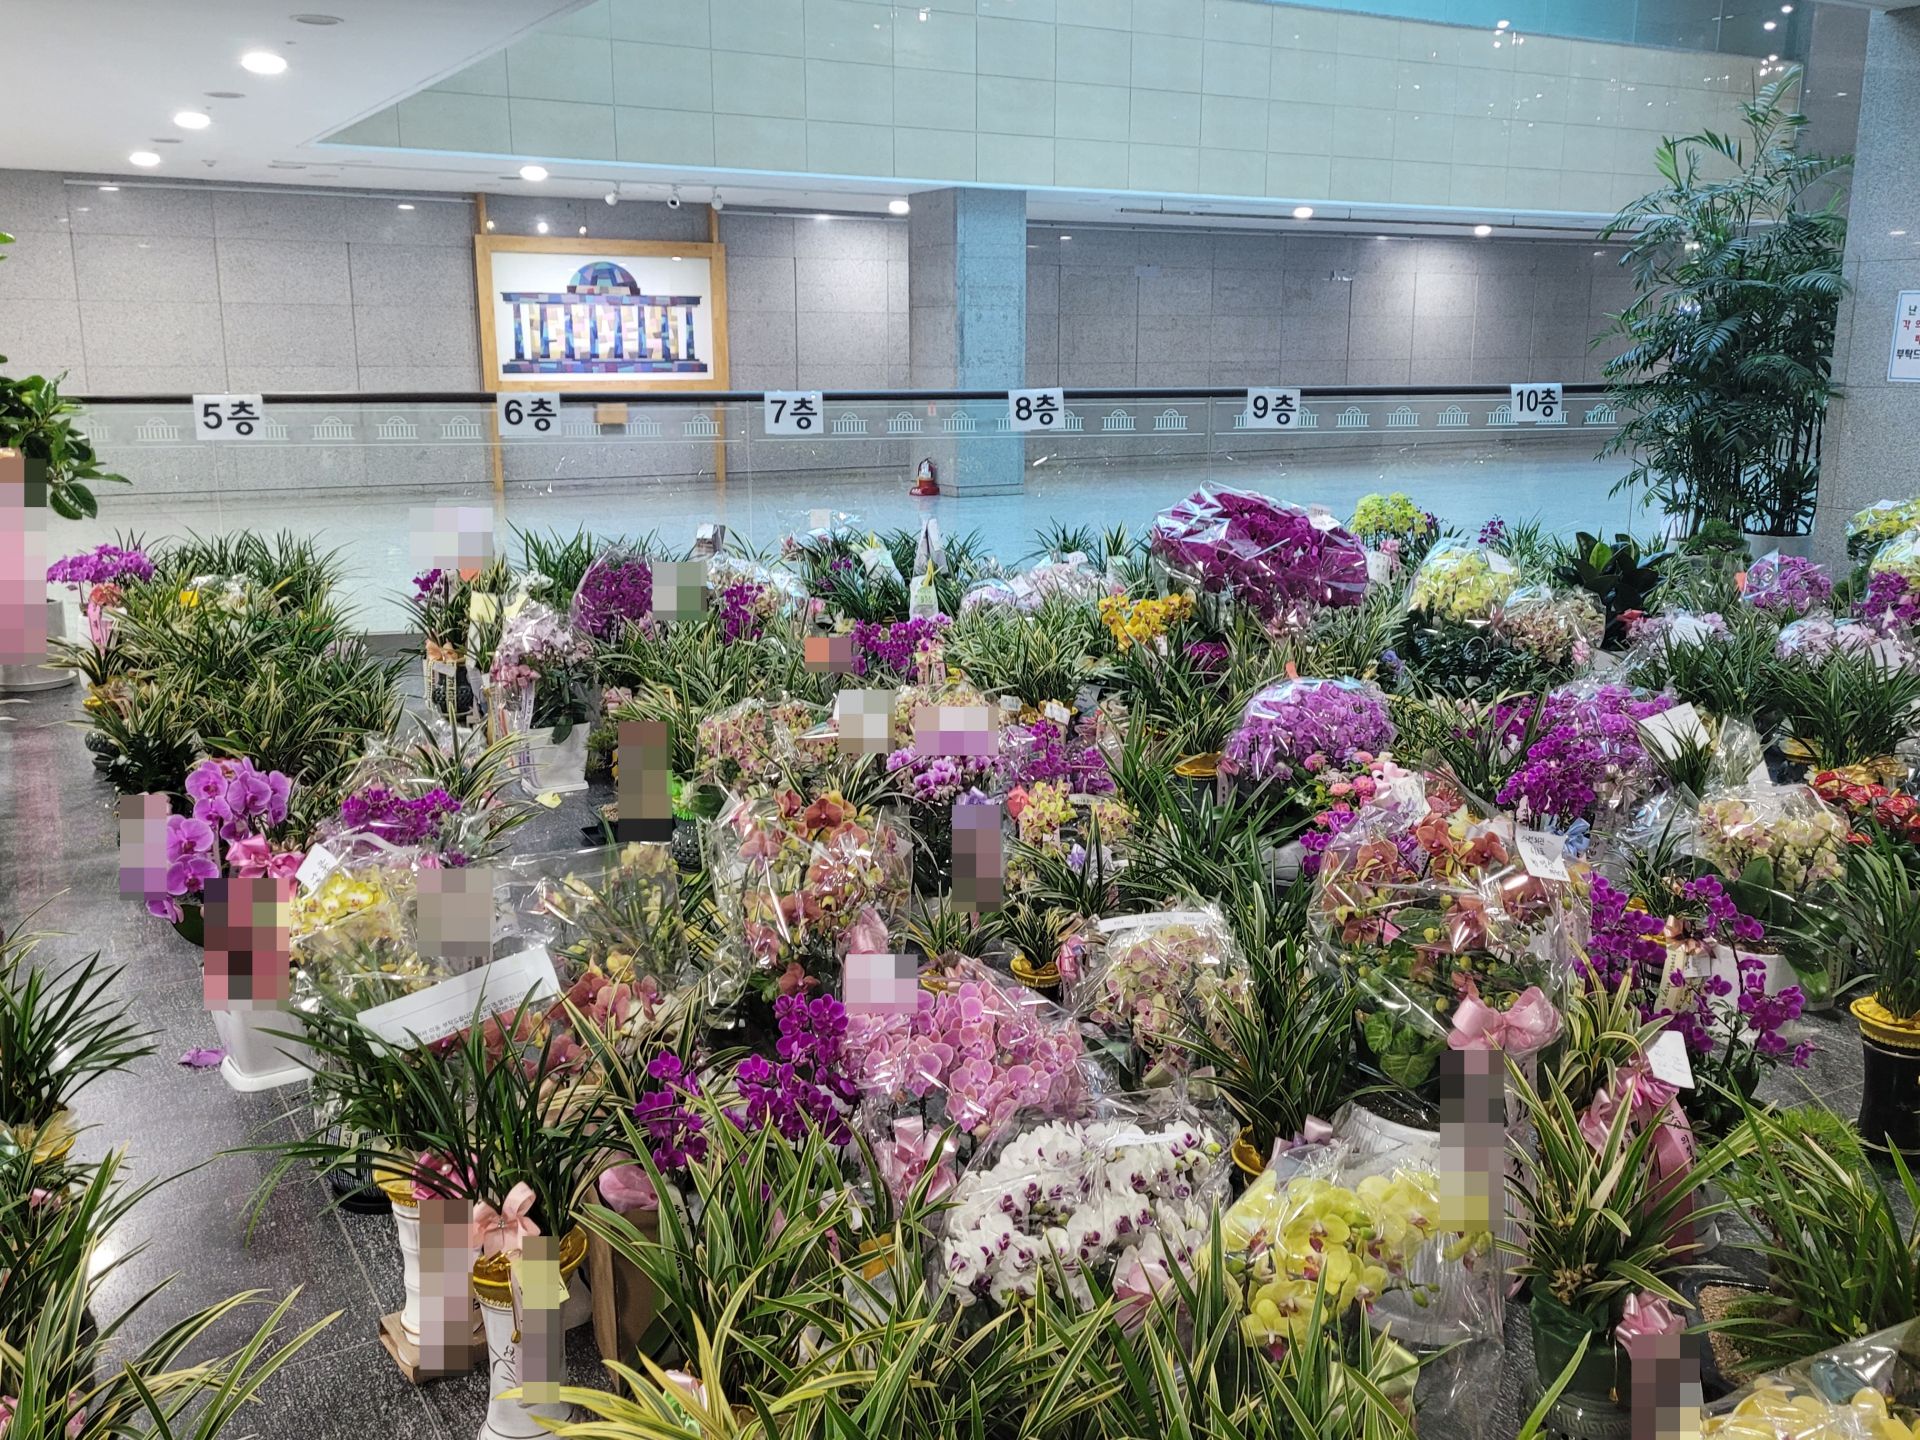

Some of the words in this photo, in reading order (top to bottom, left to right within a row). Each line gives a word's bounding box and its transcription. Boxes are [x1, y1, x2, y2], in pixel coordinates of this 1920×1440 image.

[203, 401, 260, 436] 5층
[504, 398, 557, 432] 6층
[770, 397, 818, 430] 7층
[1015, 394, 1059, 426] 8층
[1252, 394, 1297, 425] 9층
[1516, 387, 1559, 418] 10층
